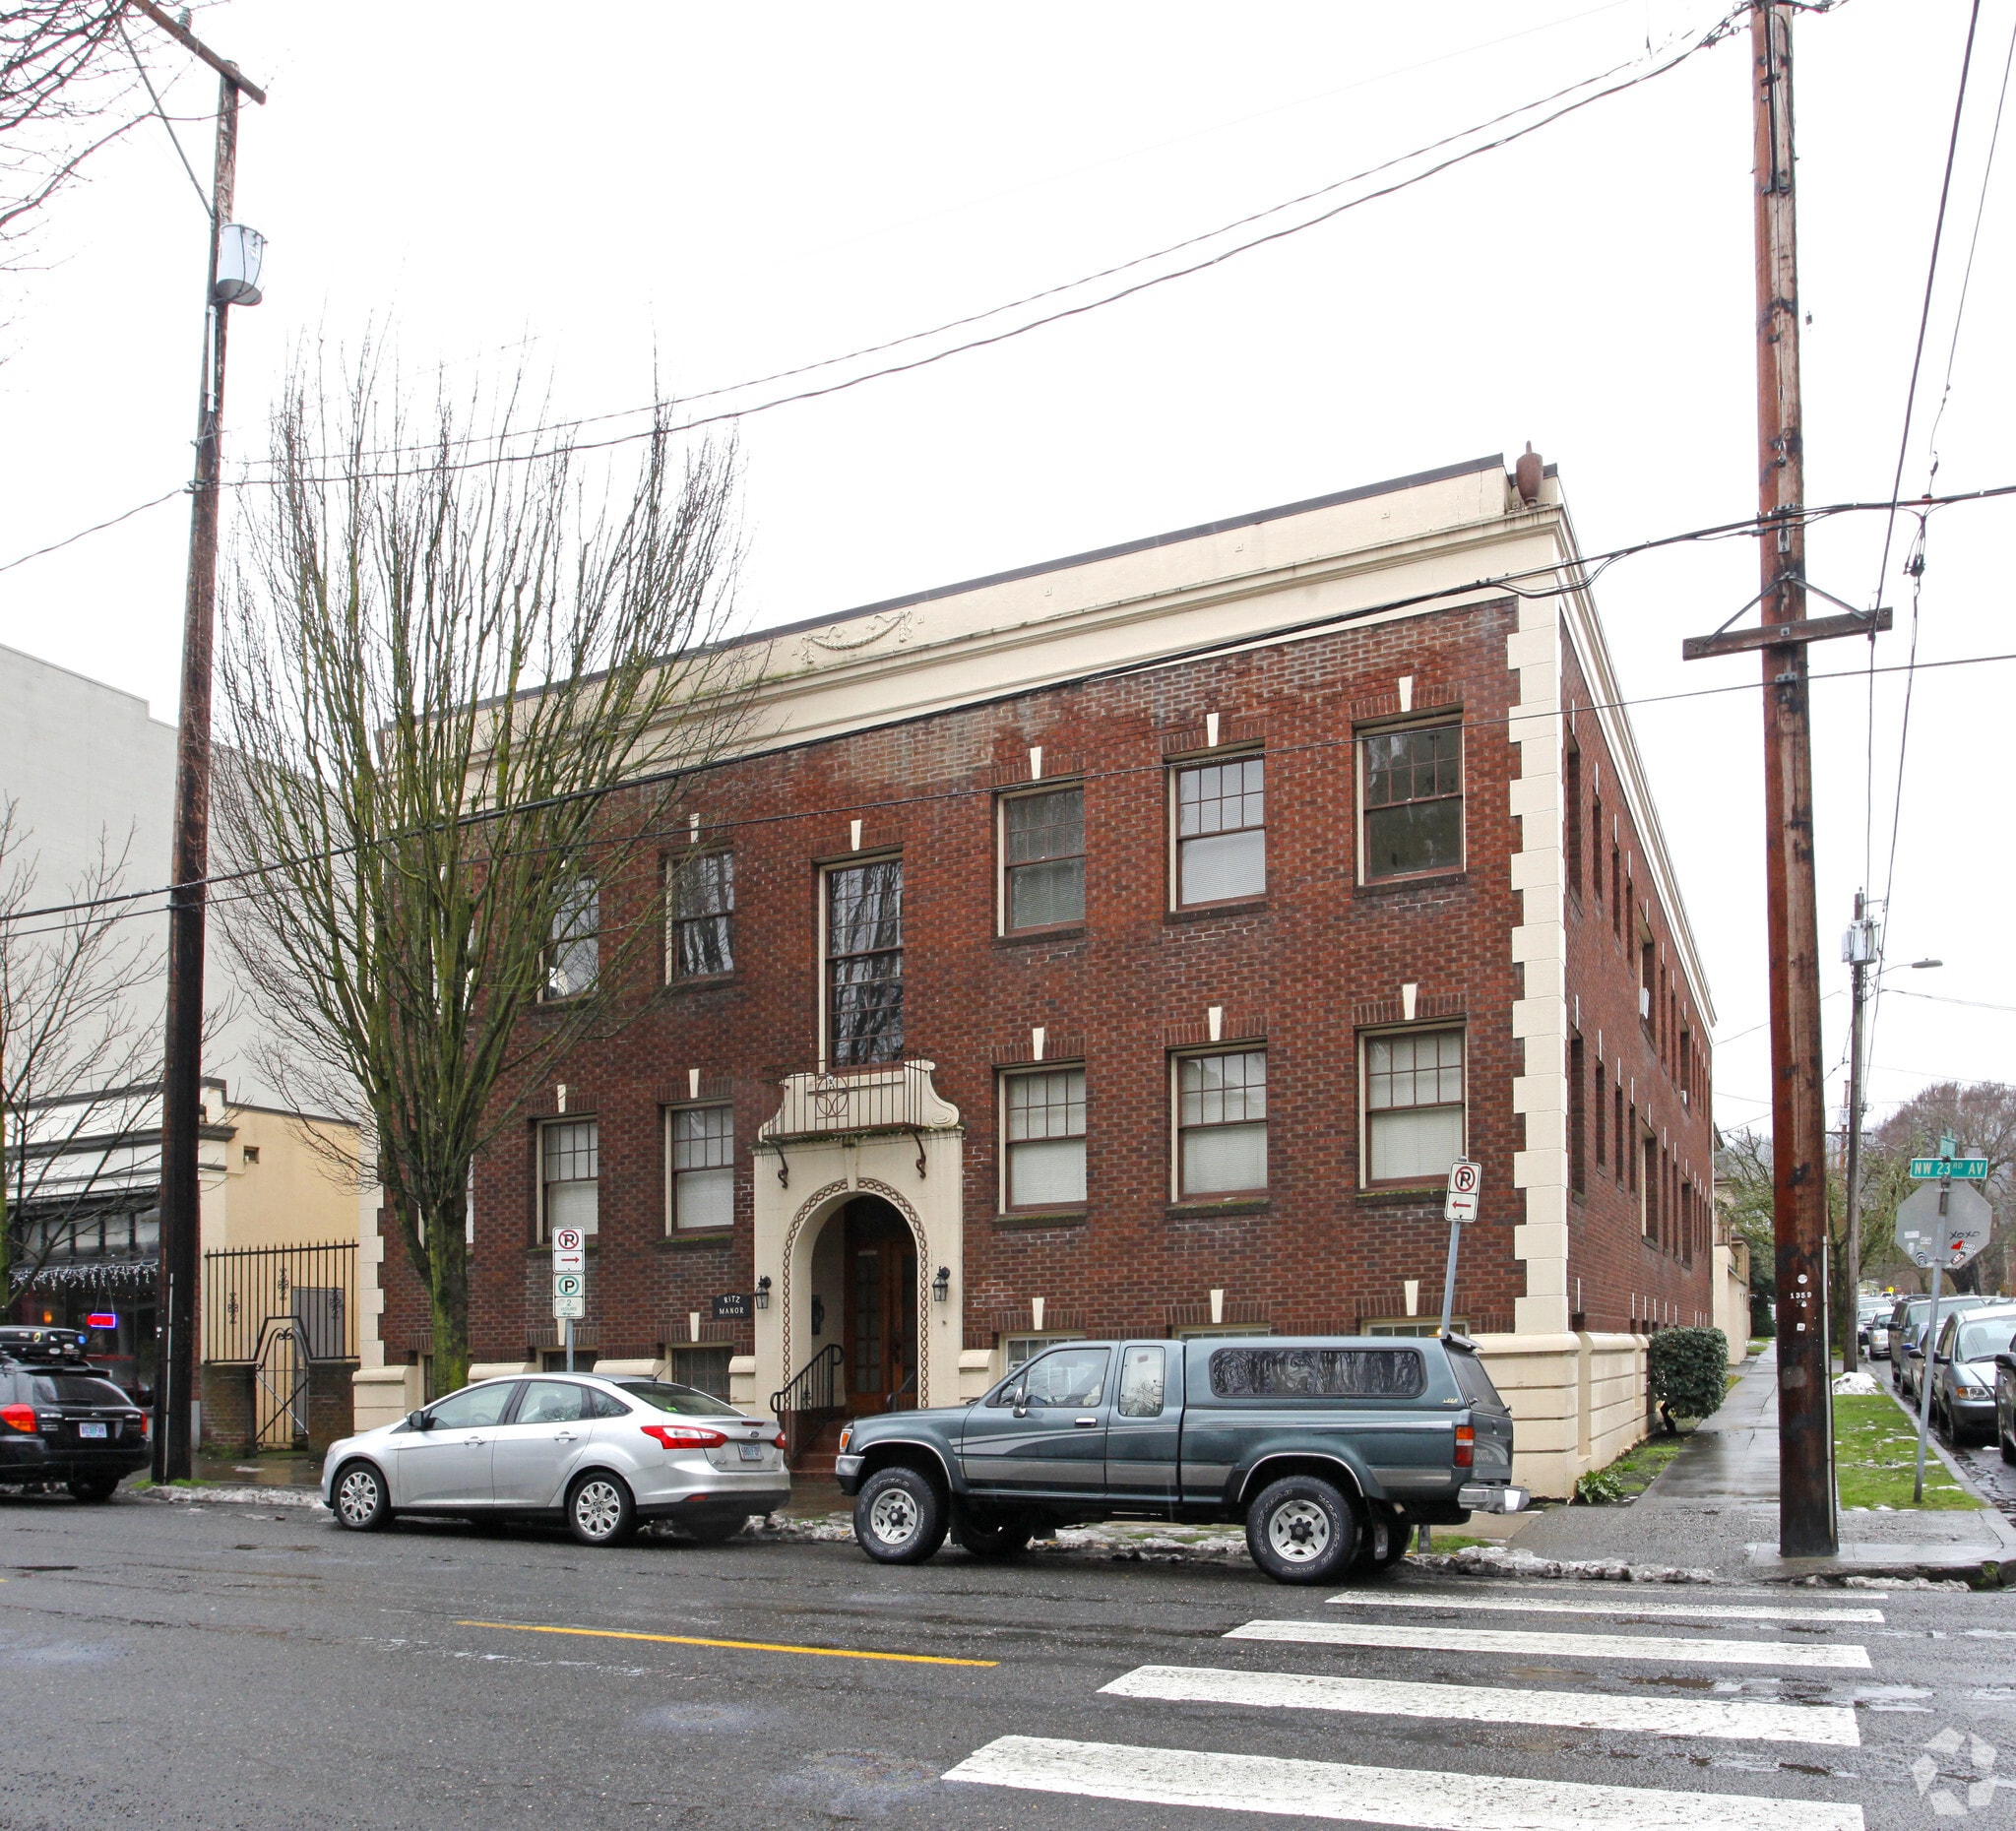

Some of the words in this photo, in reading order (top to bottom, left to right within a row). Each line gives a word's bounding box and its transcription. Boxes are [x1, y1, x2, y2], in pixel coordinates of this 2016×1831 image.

[1915, 1163, 1932, 1174] NW
[1968, 1163, 1984, 1175] AV
[564, 1280, 575, 1293] P
[724, 1294, 741, 1304] RITZ
[719, 1306, 744, 1315] MANOR
